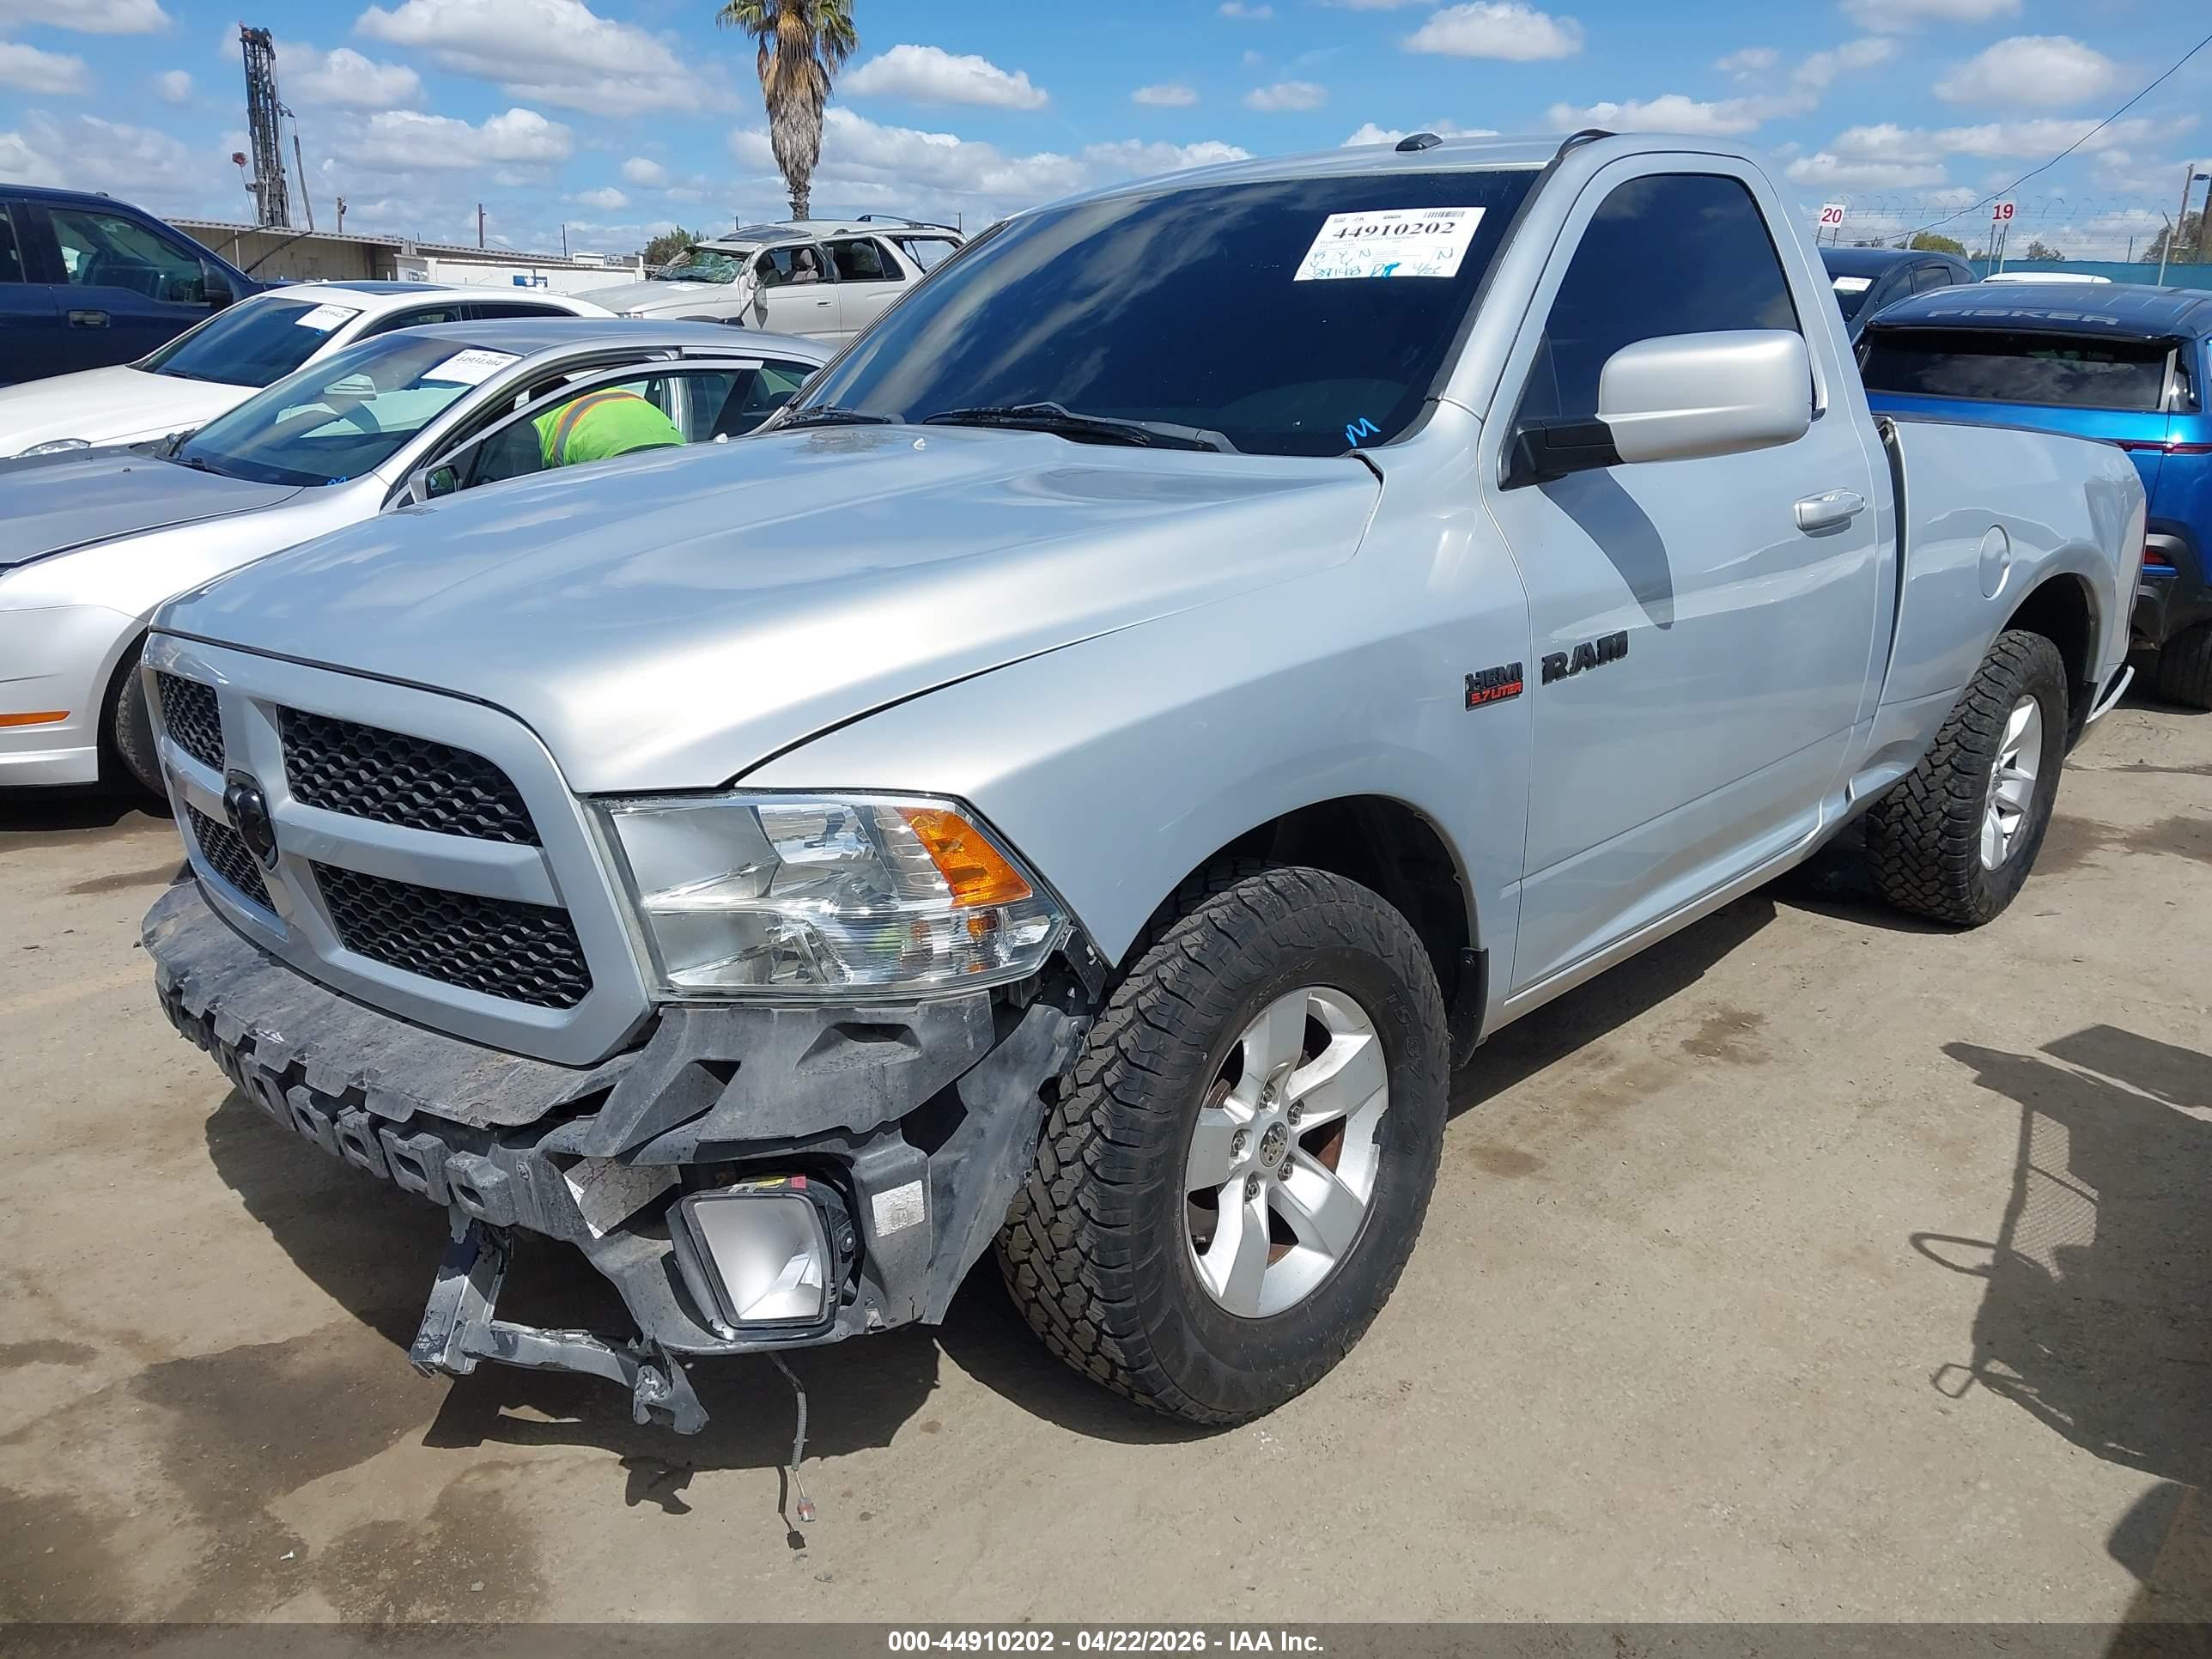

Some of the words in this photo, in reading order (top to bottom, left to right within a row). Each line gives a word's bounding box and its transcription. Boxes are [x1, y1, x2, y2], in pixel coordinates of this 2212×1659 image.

[1820, 208, 1843, 223] 20
[1991, 204, 2014, 221] 19
[1332, 221, 1456, 240] 44910202
[1925, 308, 2121, 325] FISKER
[1345, 417, 1382, 447] M
[1540, 629, 1629, 687] RAM
[1464, 661, 1523, 692] HEMI
